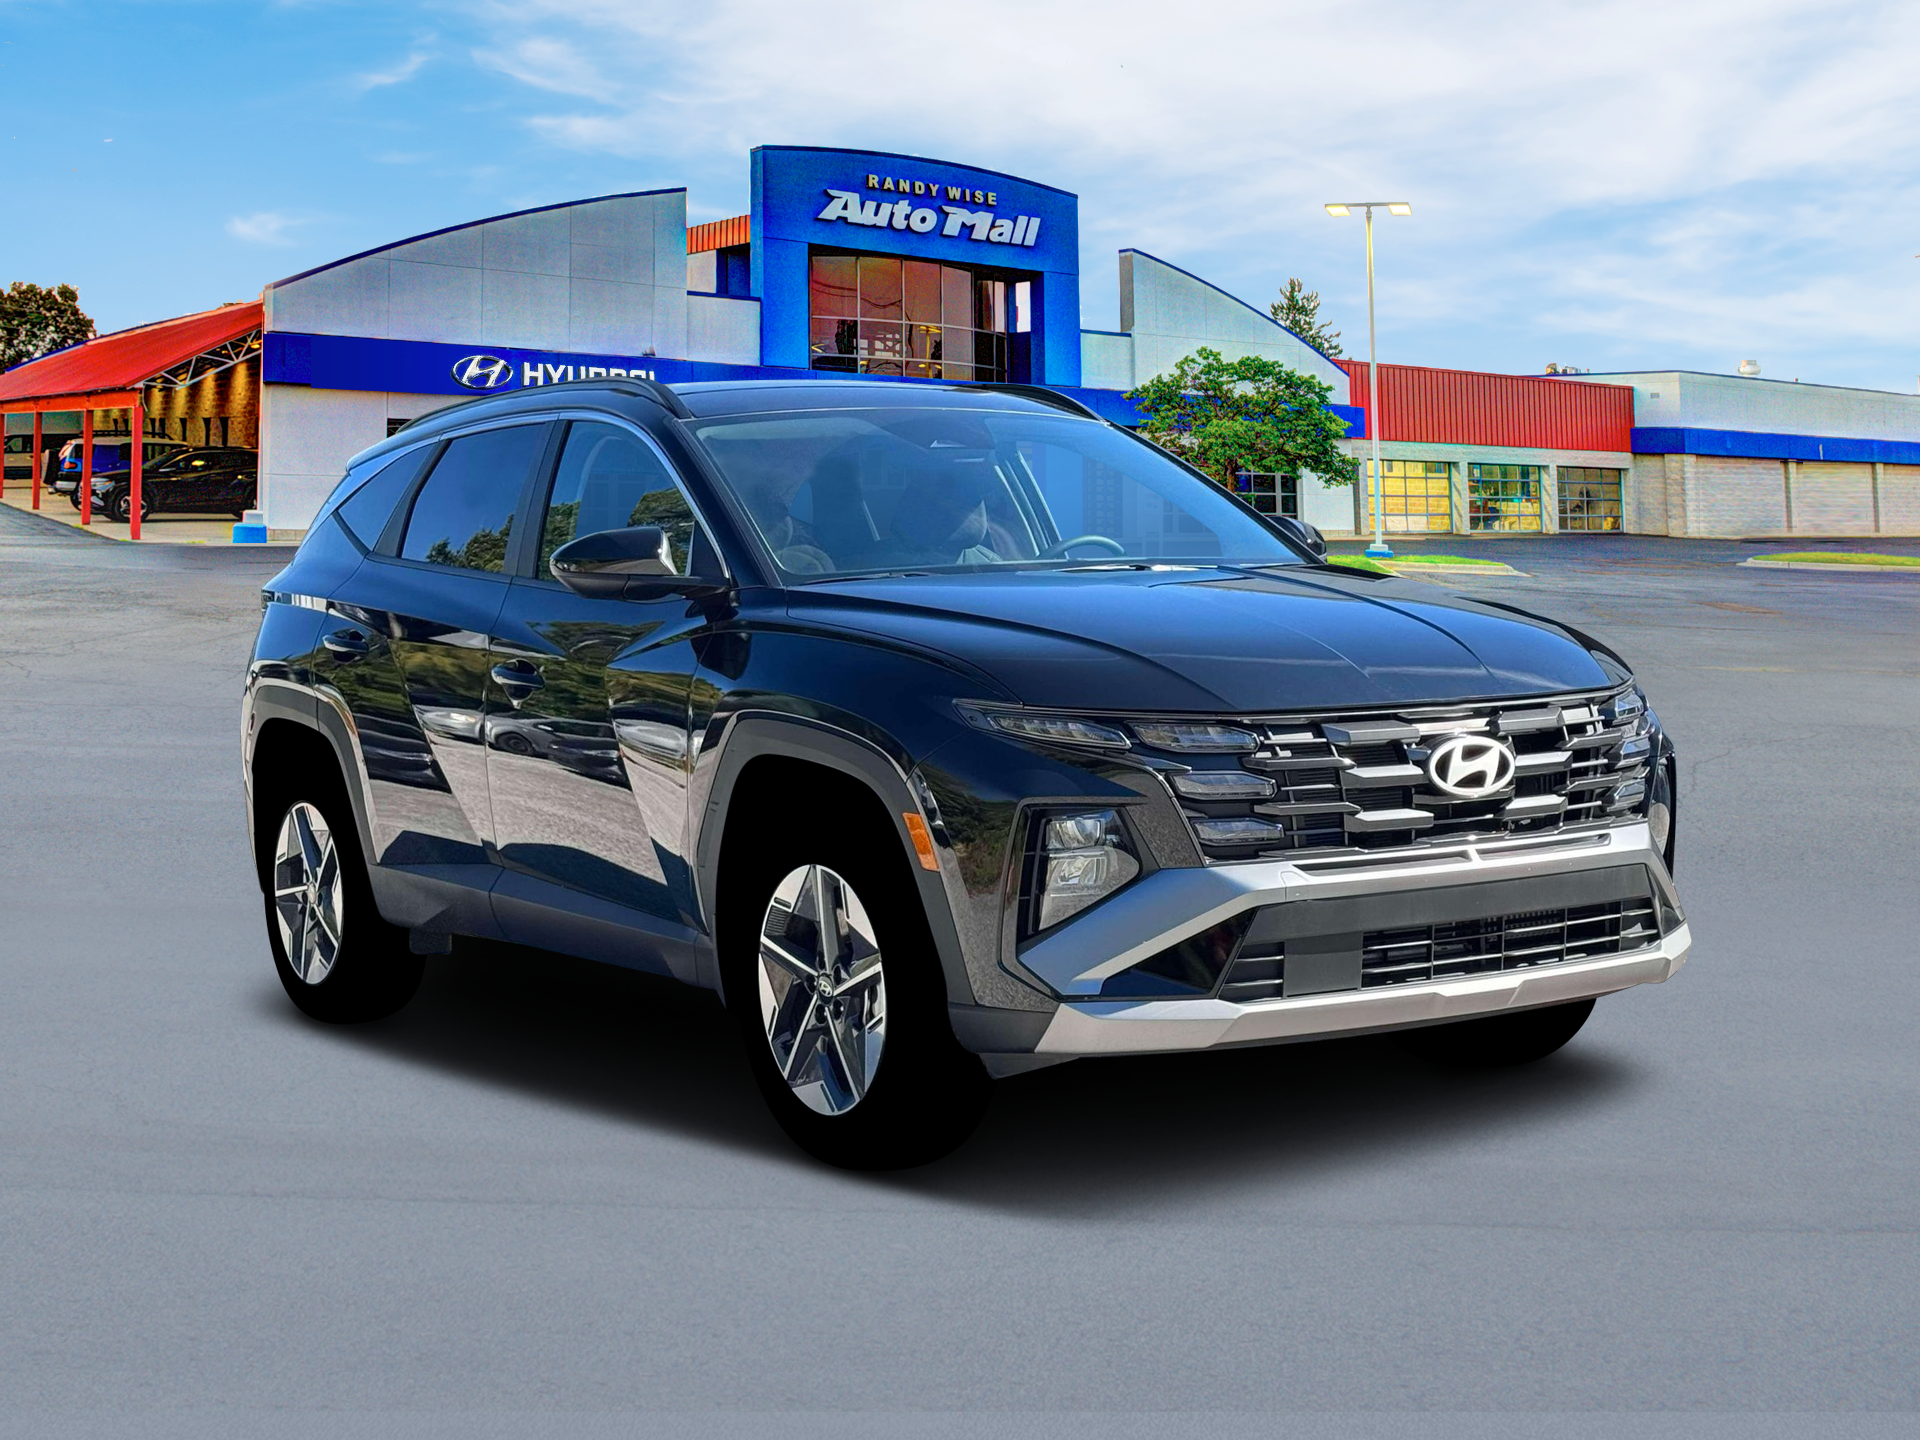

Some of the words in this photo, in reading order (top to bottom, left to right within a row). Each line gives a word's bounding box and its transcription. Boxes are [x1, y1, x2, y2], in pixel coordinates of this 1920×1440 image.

[867, 173, 940, 197] RANDY
[946, 185, 998, 206] WISE
[816, 188, 938, 233] Auto
[941, 204, 1041, 247] Mall
